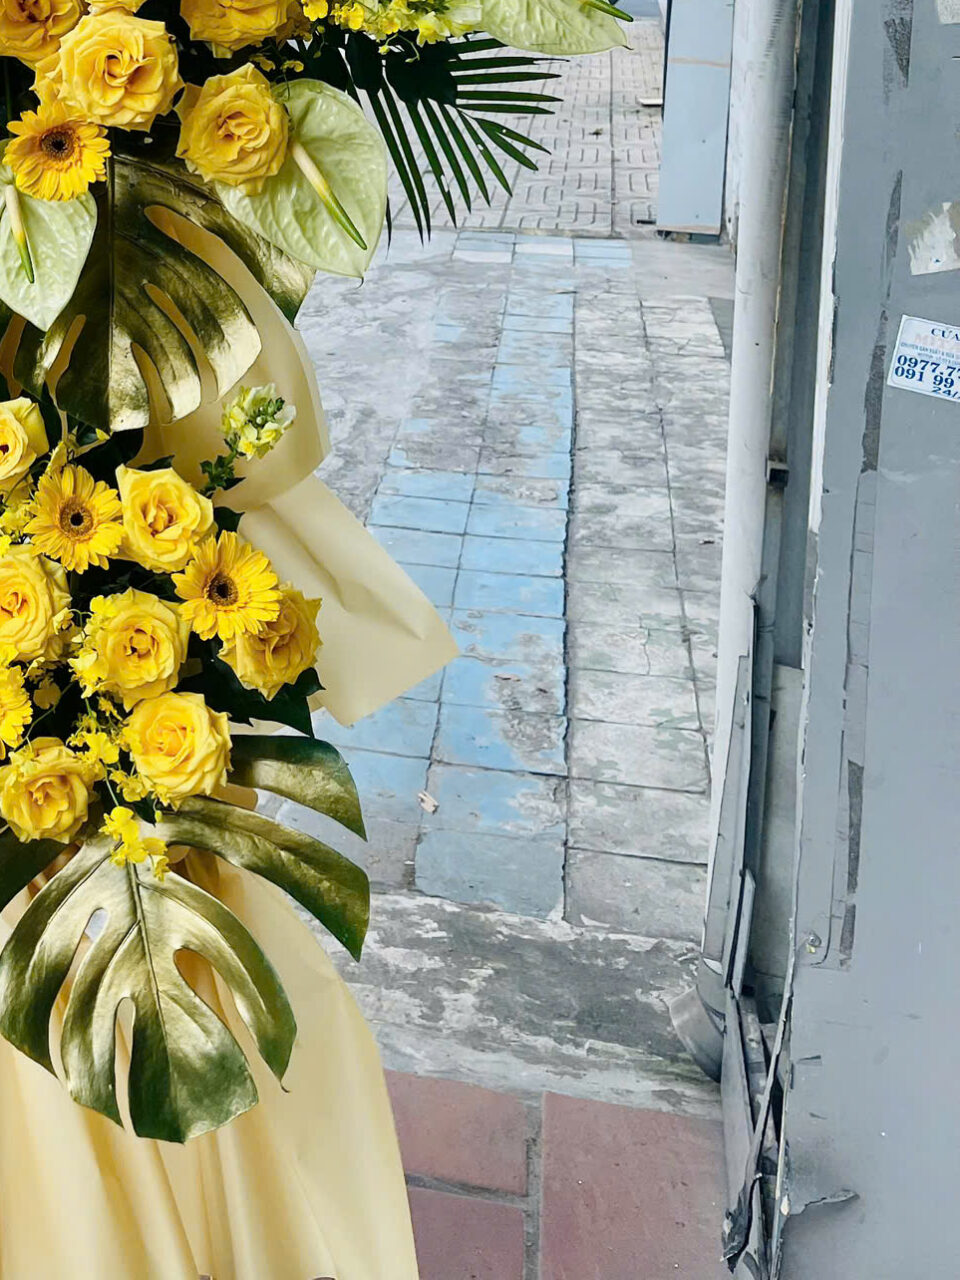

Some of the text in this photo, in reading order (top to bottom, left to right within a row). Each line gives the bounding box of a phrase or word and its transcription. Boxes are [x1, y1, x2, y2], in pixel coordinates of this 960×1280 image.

[894, 366, 955, 389] 091 99
[931, 386, 960, 400] 24/
